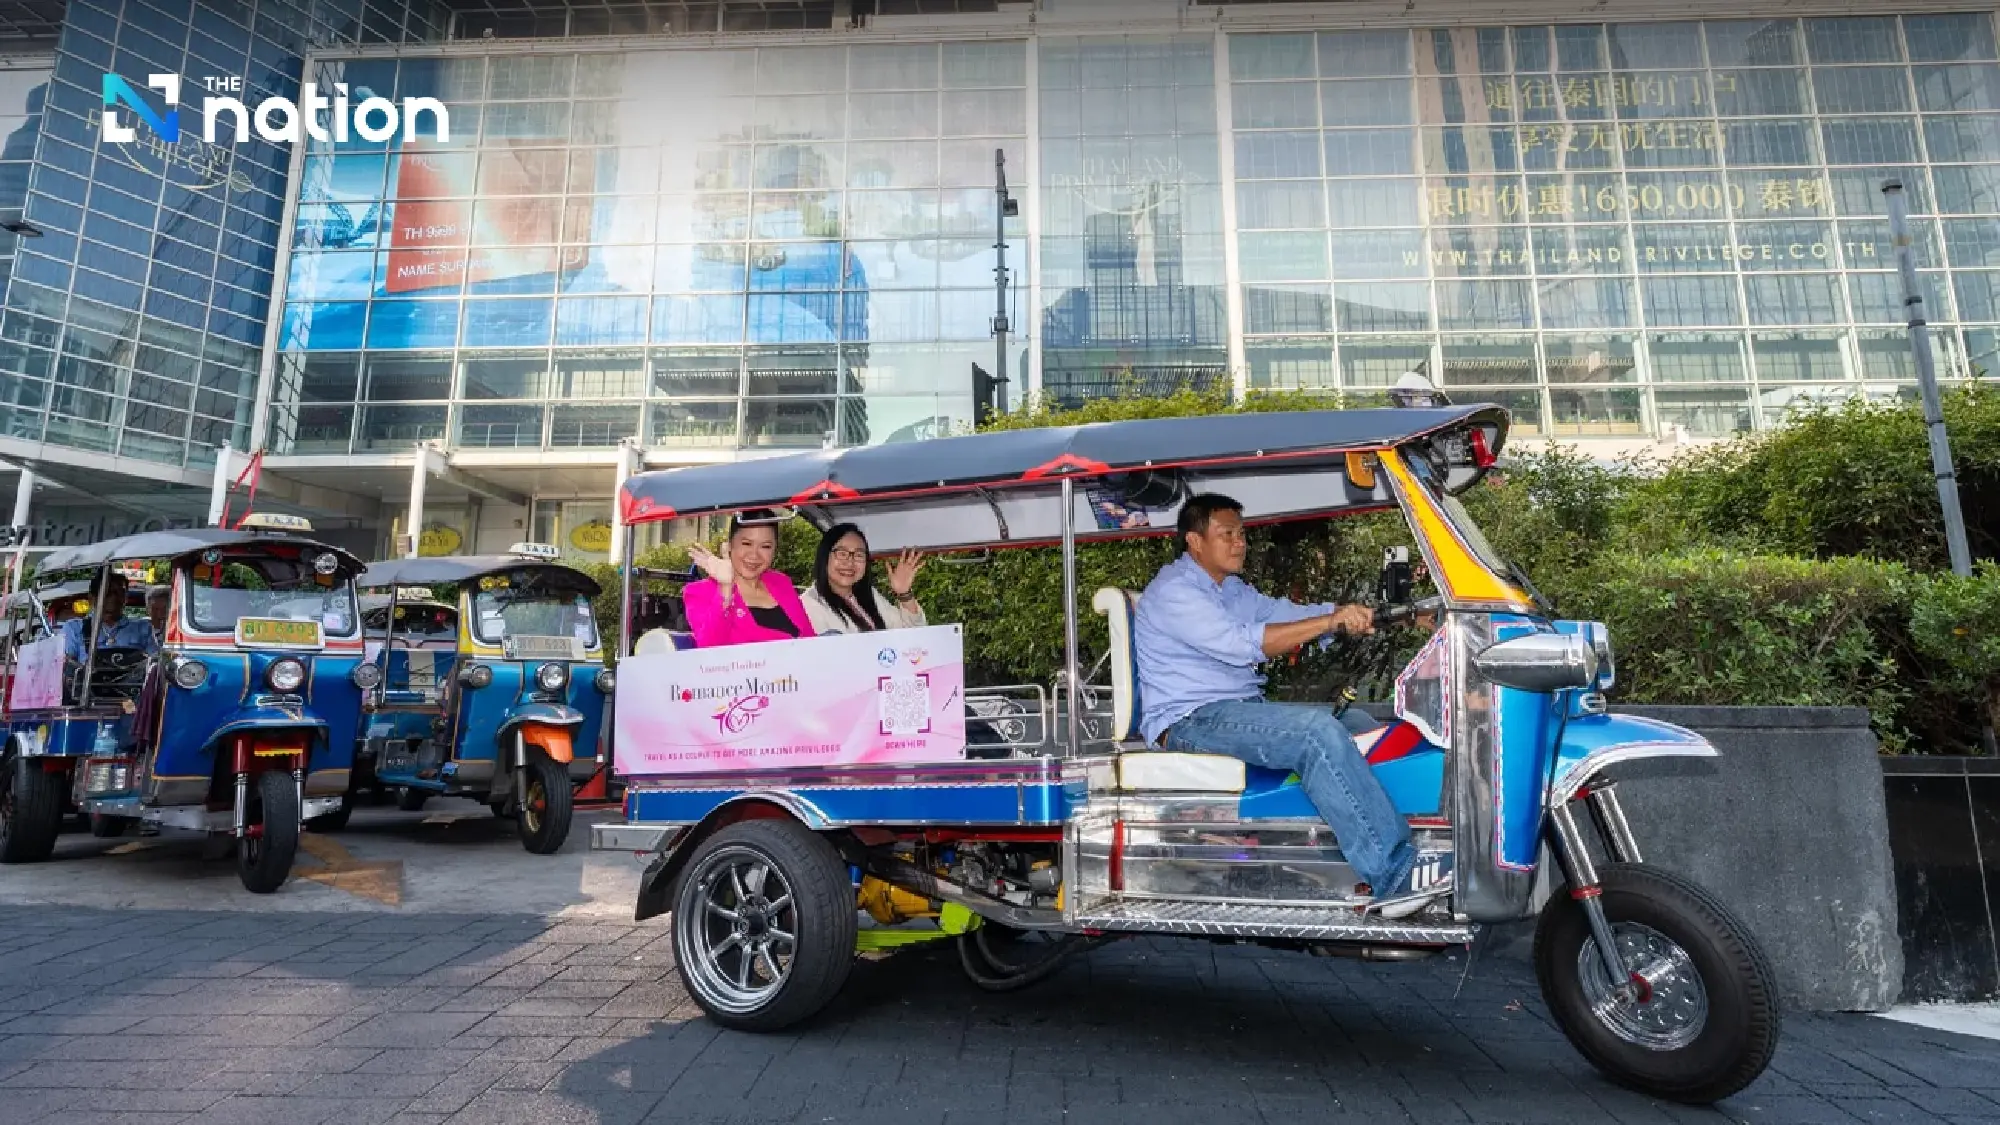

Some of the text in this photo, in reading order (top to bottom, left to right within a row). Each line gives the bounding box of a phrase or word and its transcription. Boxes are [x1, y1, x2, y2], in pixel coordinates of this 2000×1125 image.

[404, 226, 423, 240] TH
[397, 264, 435, 278] NAME
[264, 514, 304, 527] TAXI
[525, 546, 556, 556] TAXI
[745, 674, 798, 695] Month
[738, 748, 758, 758] MORE
